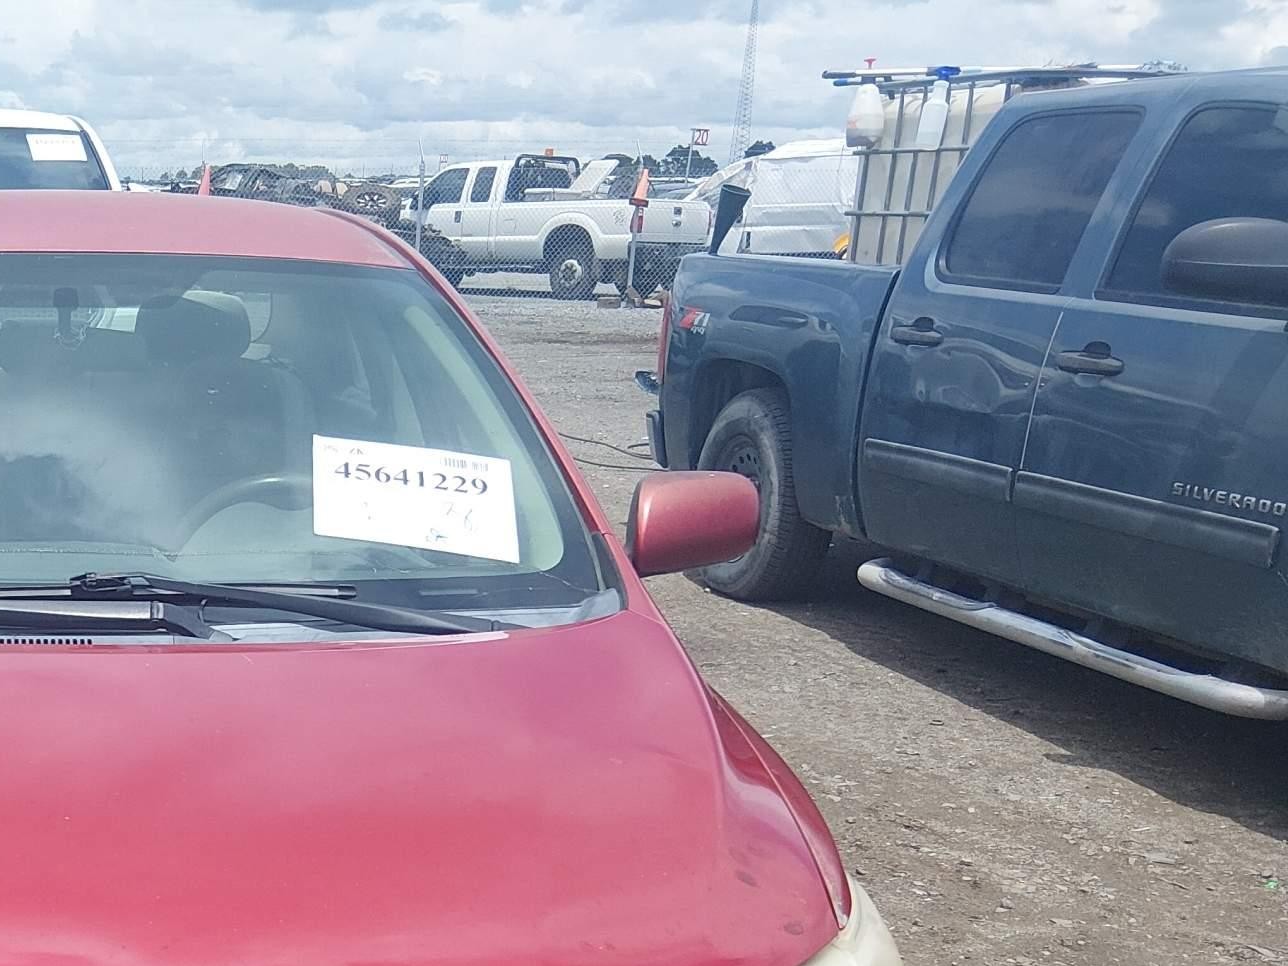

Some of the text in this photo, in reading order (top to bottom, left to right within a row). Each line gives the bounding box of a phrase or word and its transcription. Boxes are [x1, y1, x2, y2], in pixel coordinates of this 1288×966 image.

[695, 129, 709, 146] 20
[334, 461, 488, 495] 45641229
[1172, 482, 1287, 516] SILVERADO
